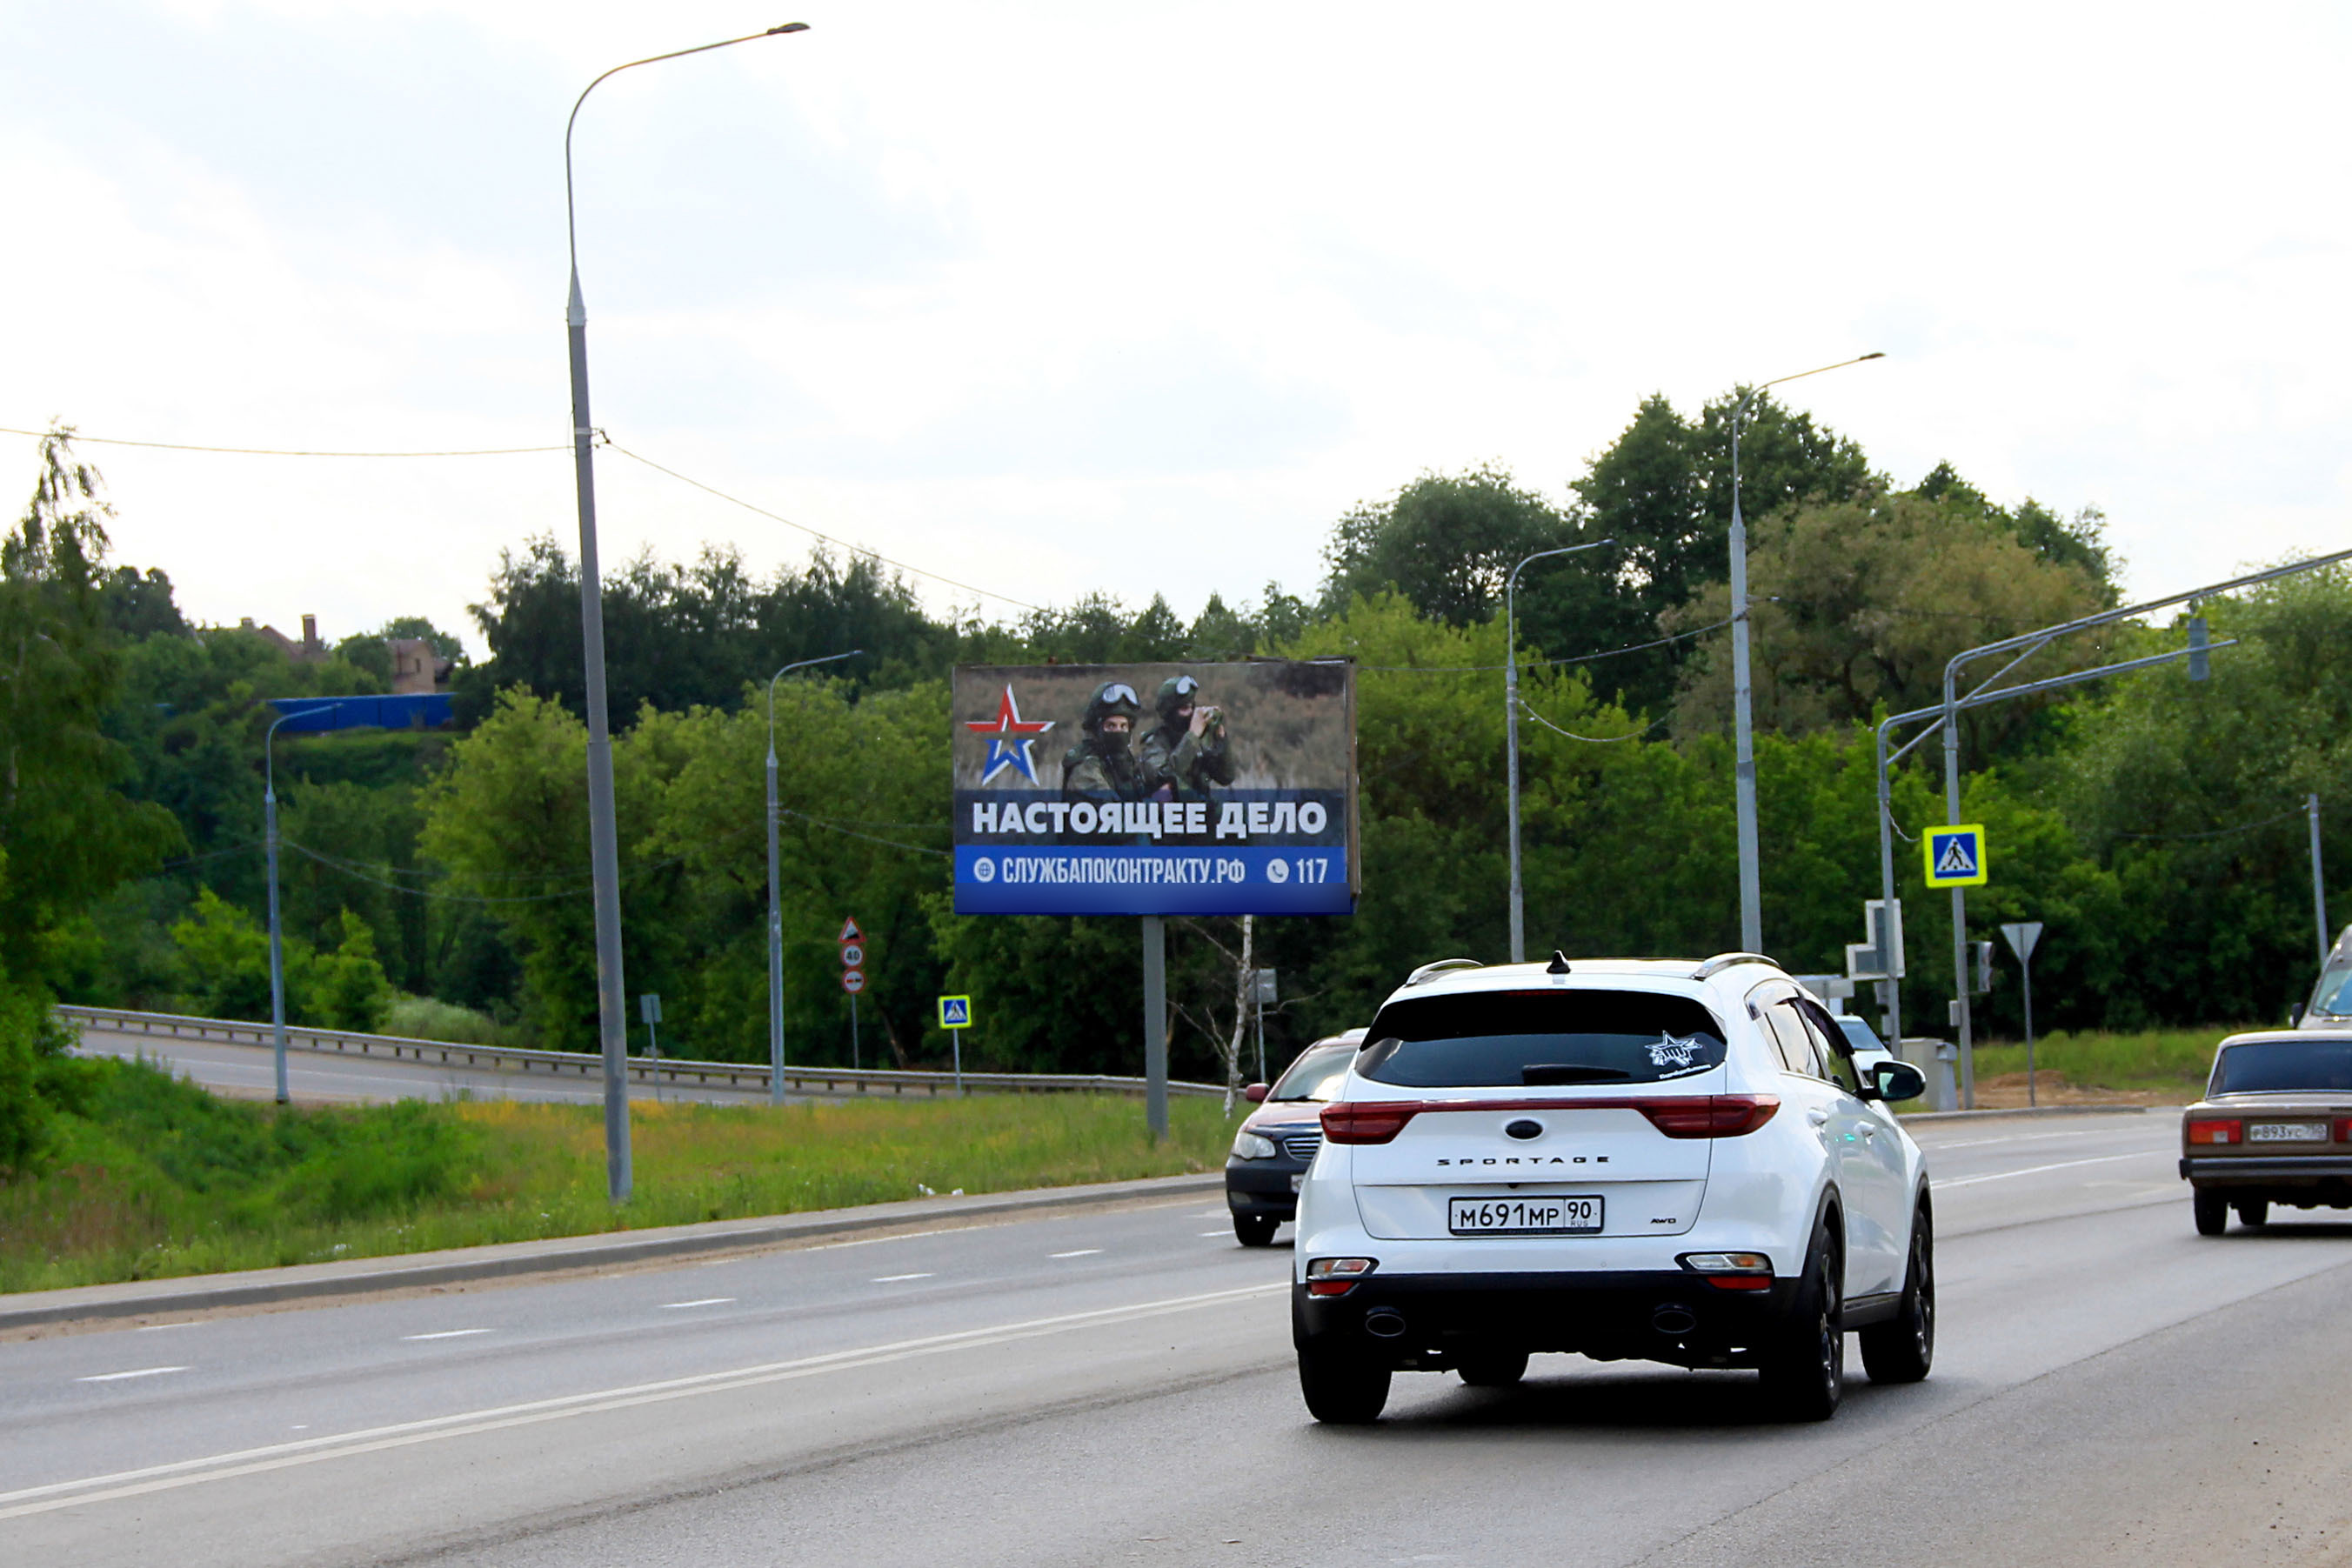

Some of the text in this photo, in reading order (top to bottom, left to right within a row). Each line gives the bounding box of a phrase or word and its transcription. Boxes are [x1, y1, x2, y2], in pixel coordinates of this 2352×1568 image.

[973, 802, 1327, 839] НАСТОЯЩЕЕ ДЕЛО
[1003, 857, 1328, 884] СЛУЖБАПОКОНТРАКТУ.РФ 117
[846, 950, 860, 961] 40
[1437, 1156, 1610, 1166] SPORTAGE
[1460, 1201, 1592, 1228] М691МР 90
